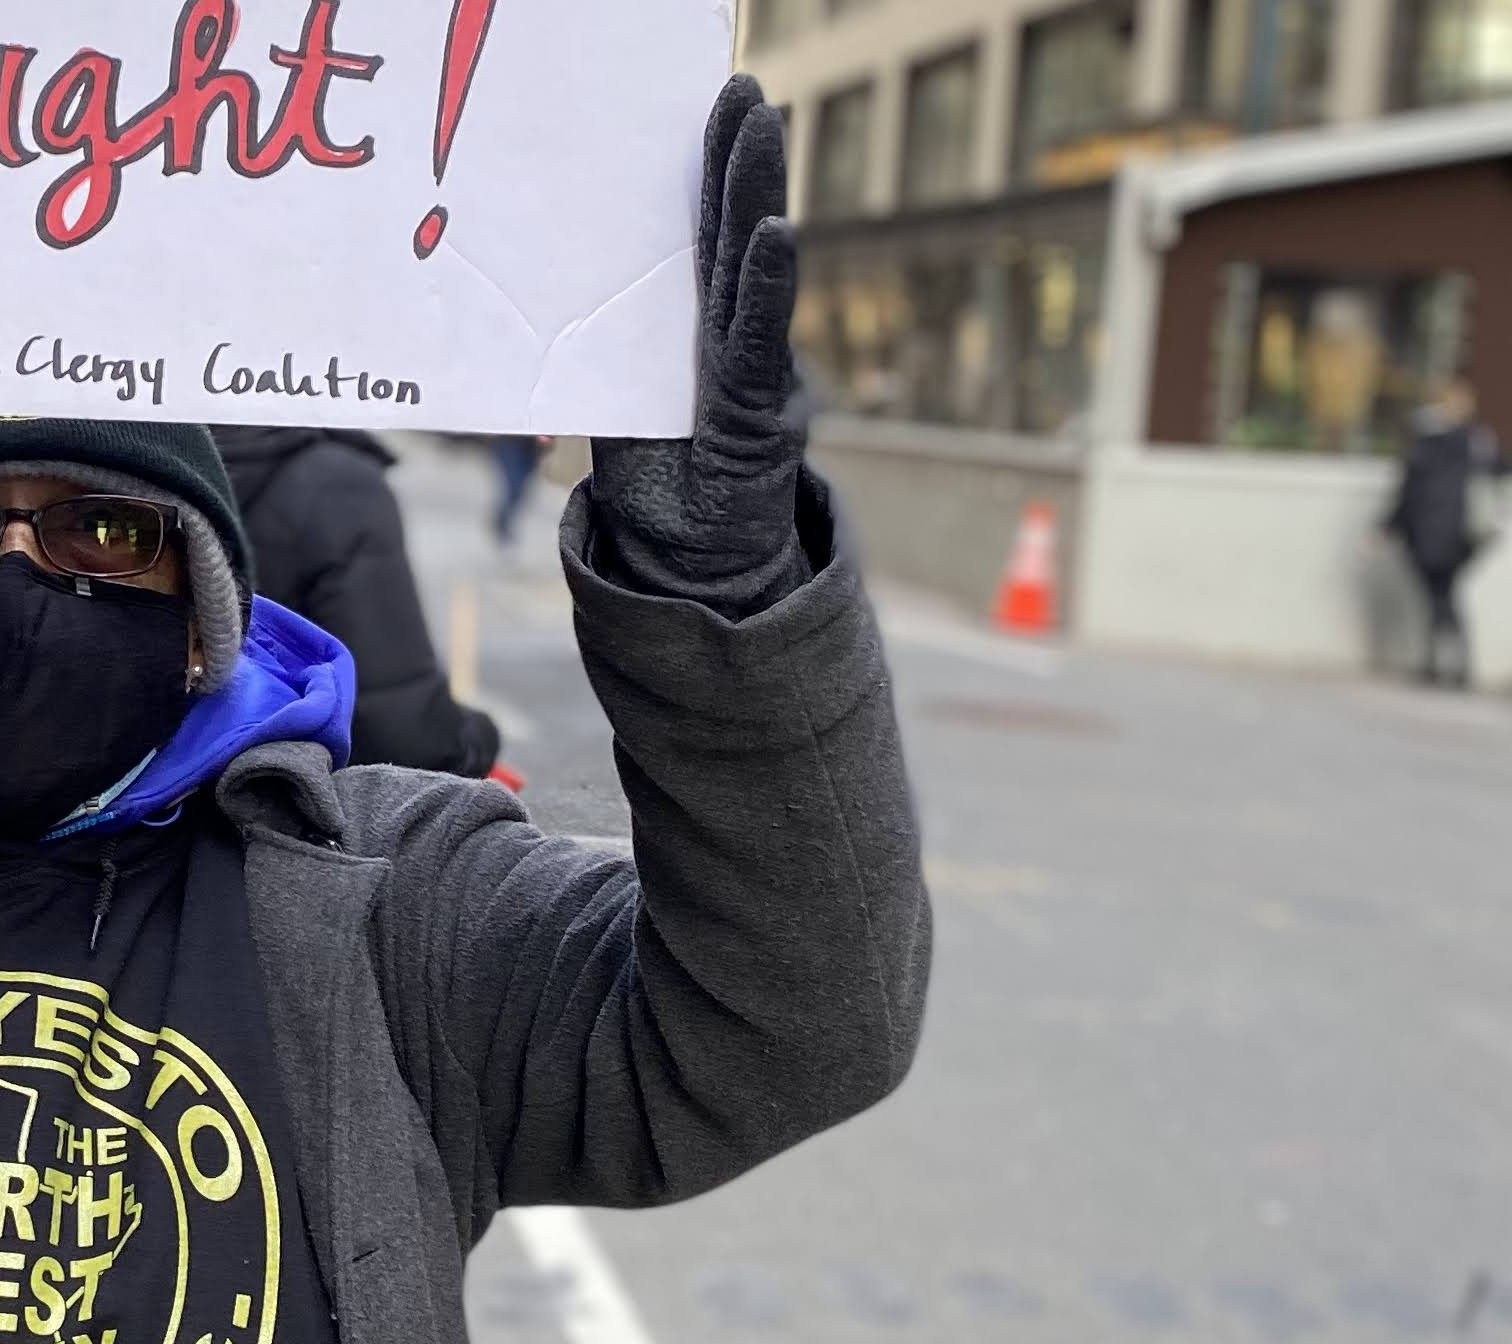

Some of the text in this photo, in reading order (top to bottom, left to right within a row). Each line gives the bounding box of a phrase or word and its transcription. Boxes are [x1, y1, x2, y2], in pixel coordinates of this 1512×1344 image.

[15, 335, 164, 405] Clergy
[203, 342, 420, 405] Coalition
[54, 1116, 128, 1166] THE
[145, 1049, 243, 1202] TO
